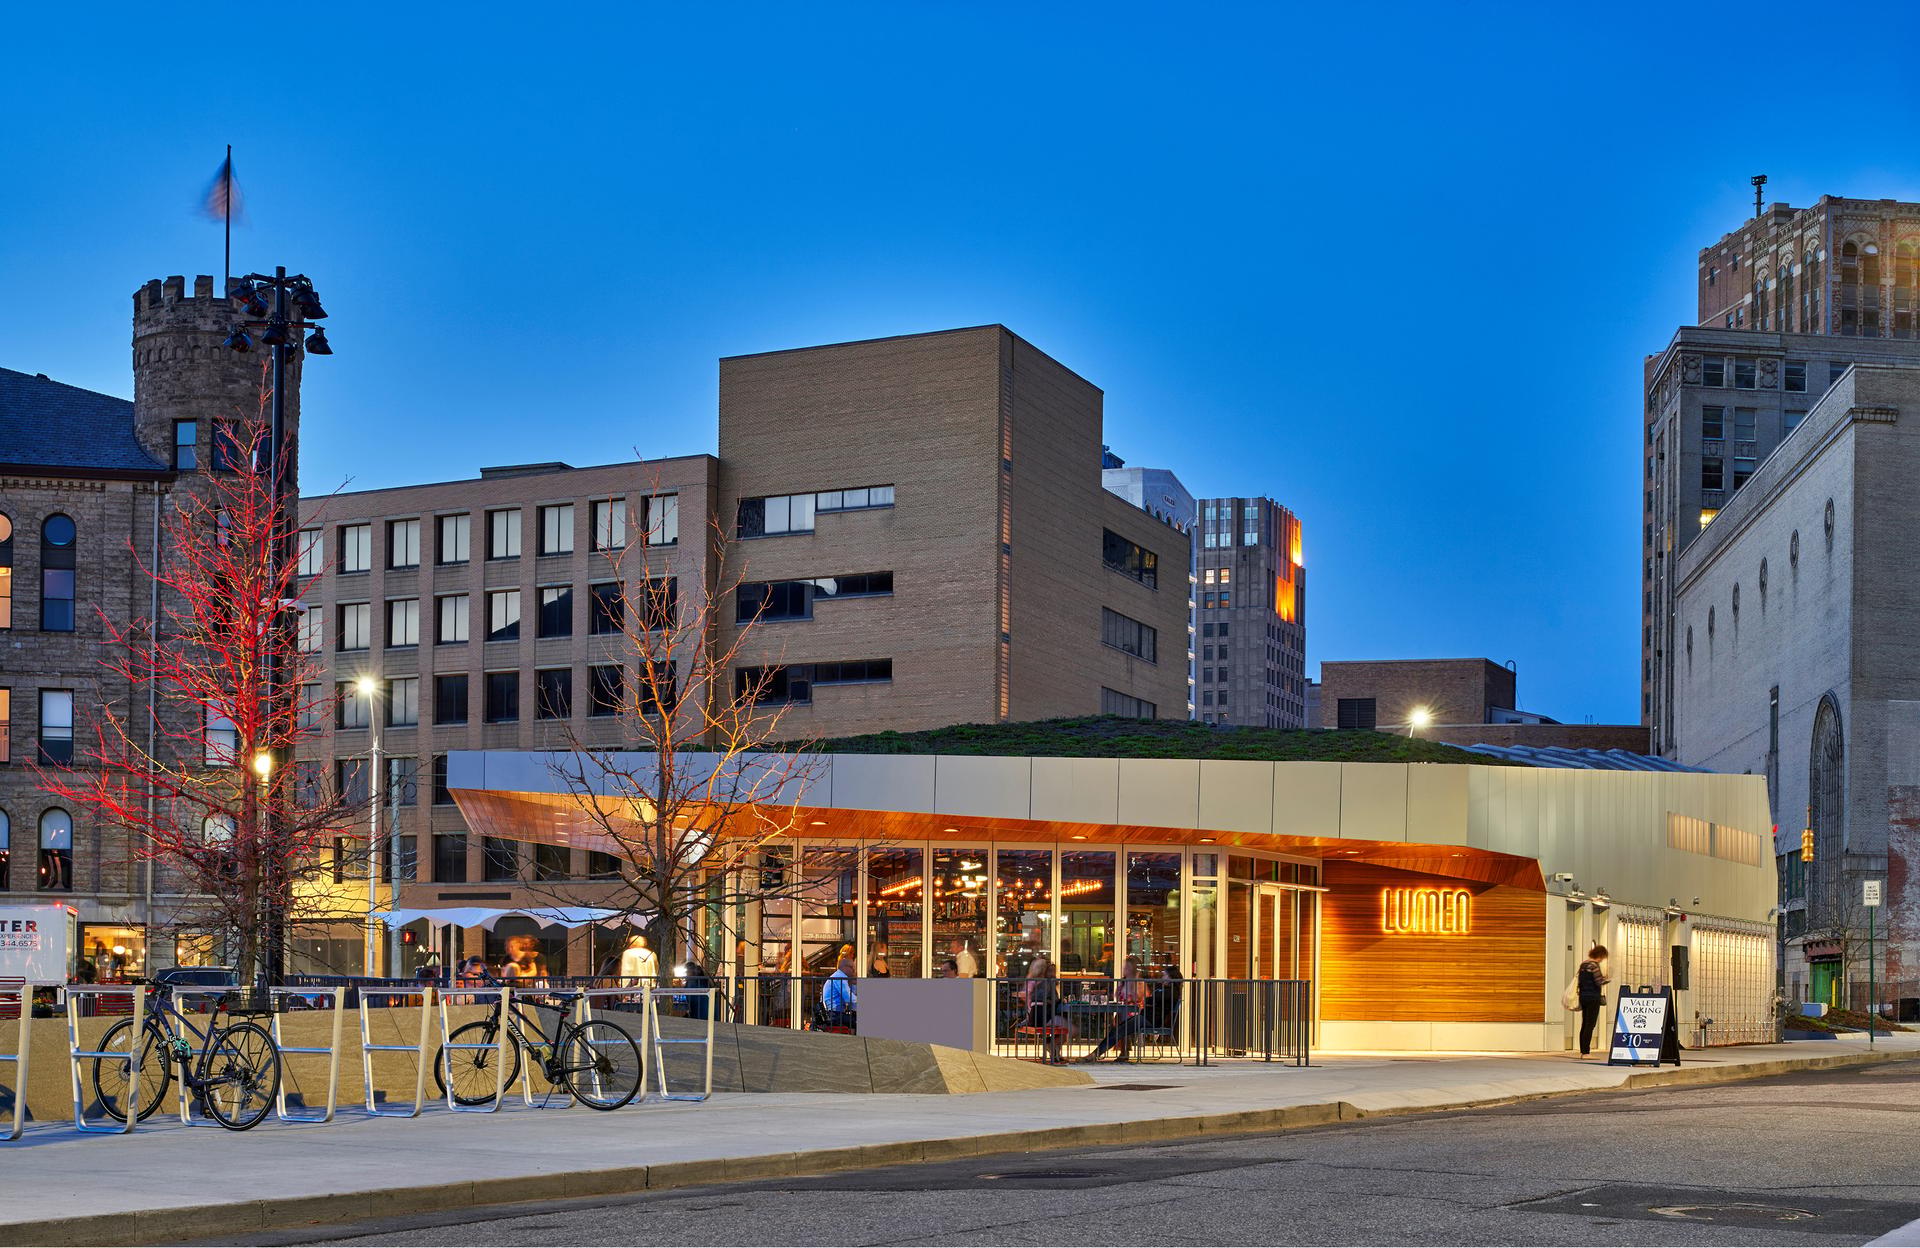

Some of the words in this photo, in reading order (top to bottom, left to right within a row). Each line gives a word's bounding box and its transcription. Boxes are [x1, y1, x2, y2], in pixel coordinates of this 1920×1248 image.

[1385, 889, 1470, 931] LUMEN
[1623, 1006, 1661, 1014] PARKING
[1622, 1033, 1642, 1047] $10
